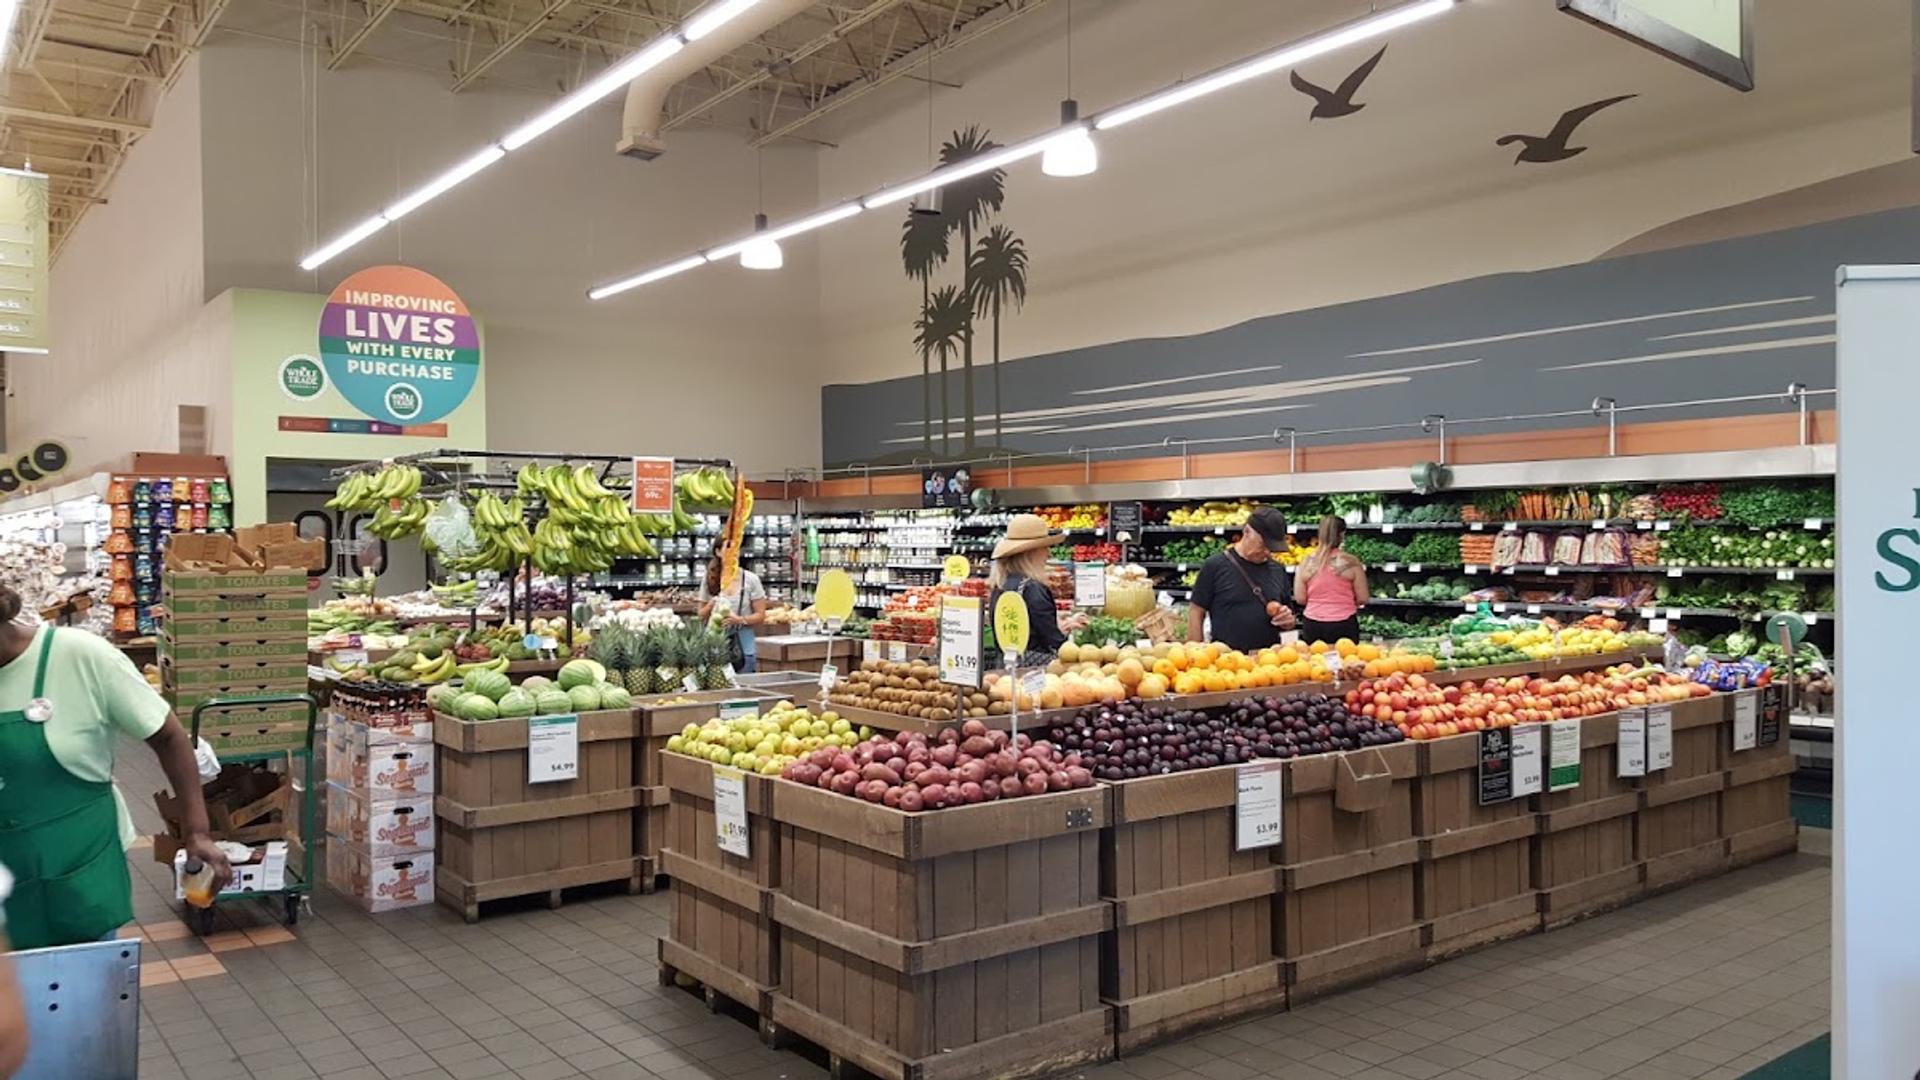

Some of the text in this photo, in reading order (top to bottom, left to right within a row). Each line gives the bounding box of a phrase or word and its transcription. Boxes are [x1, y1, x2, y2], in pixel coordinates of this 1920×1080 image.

[345, 289, 457, 314] IMPROVING
[345, 309, 456, 345] LIVES
[346, 341, 456, 362] WITH EVERY
[347, 360, 453, 380] PURCHASE
[228, 576, 289, 588] TOMATES
[228, 599, 289, 610] TOMATES
[955, 655, 976, 668] $1.99
[1256, 822, 1278, 834] $3.99
